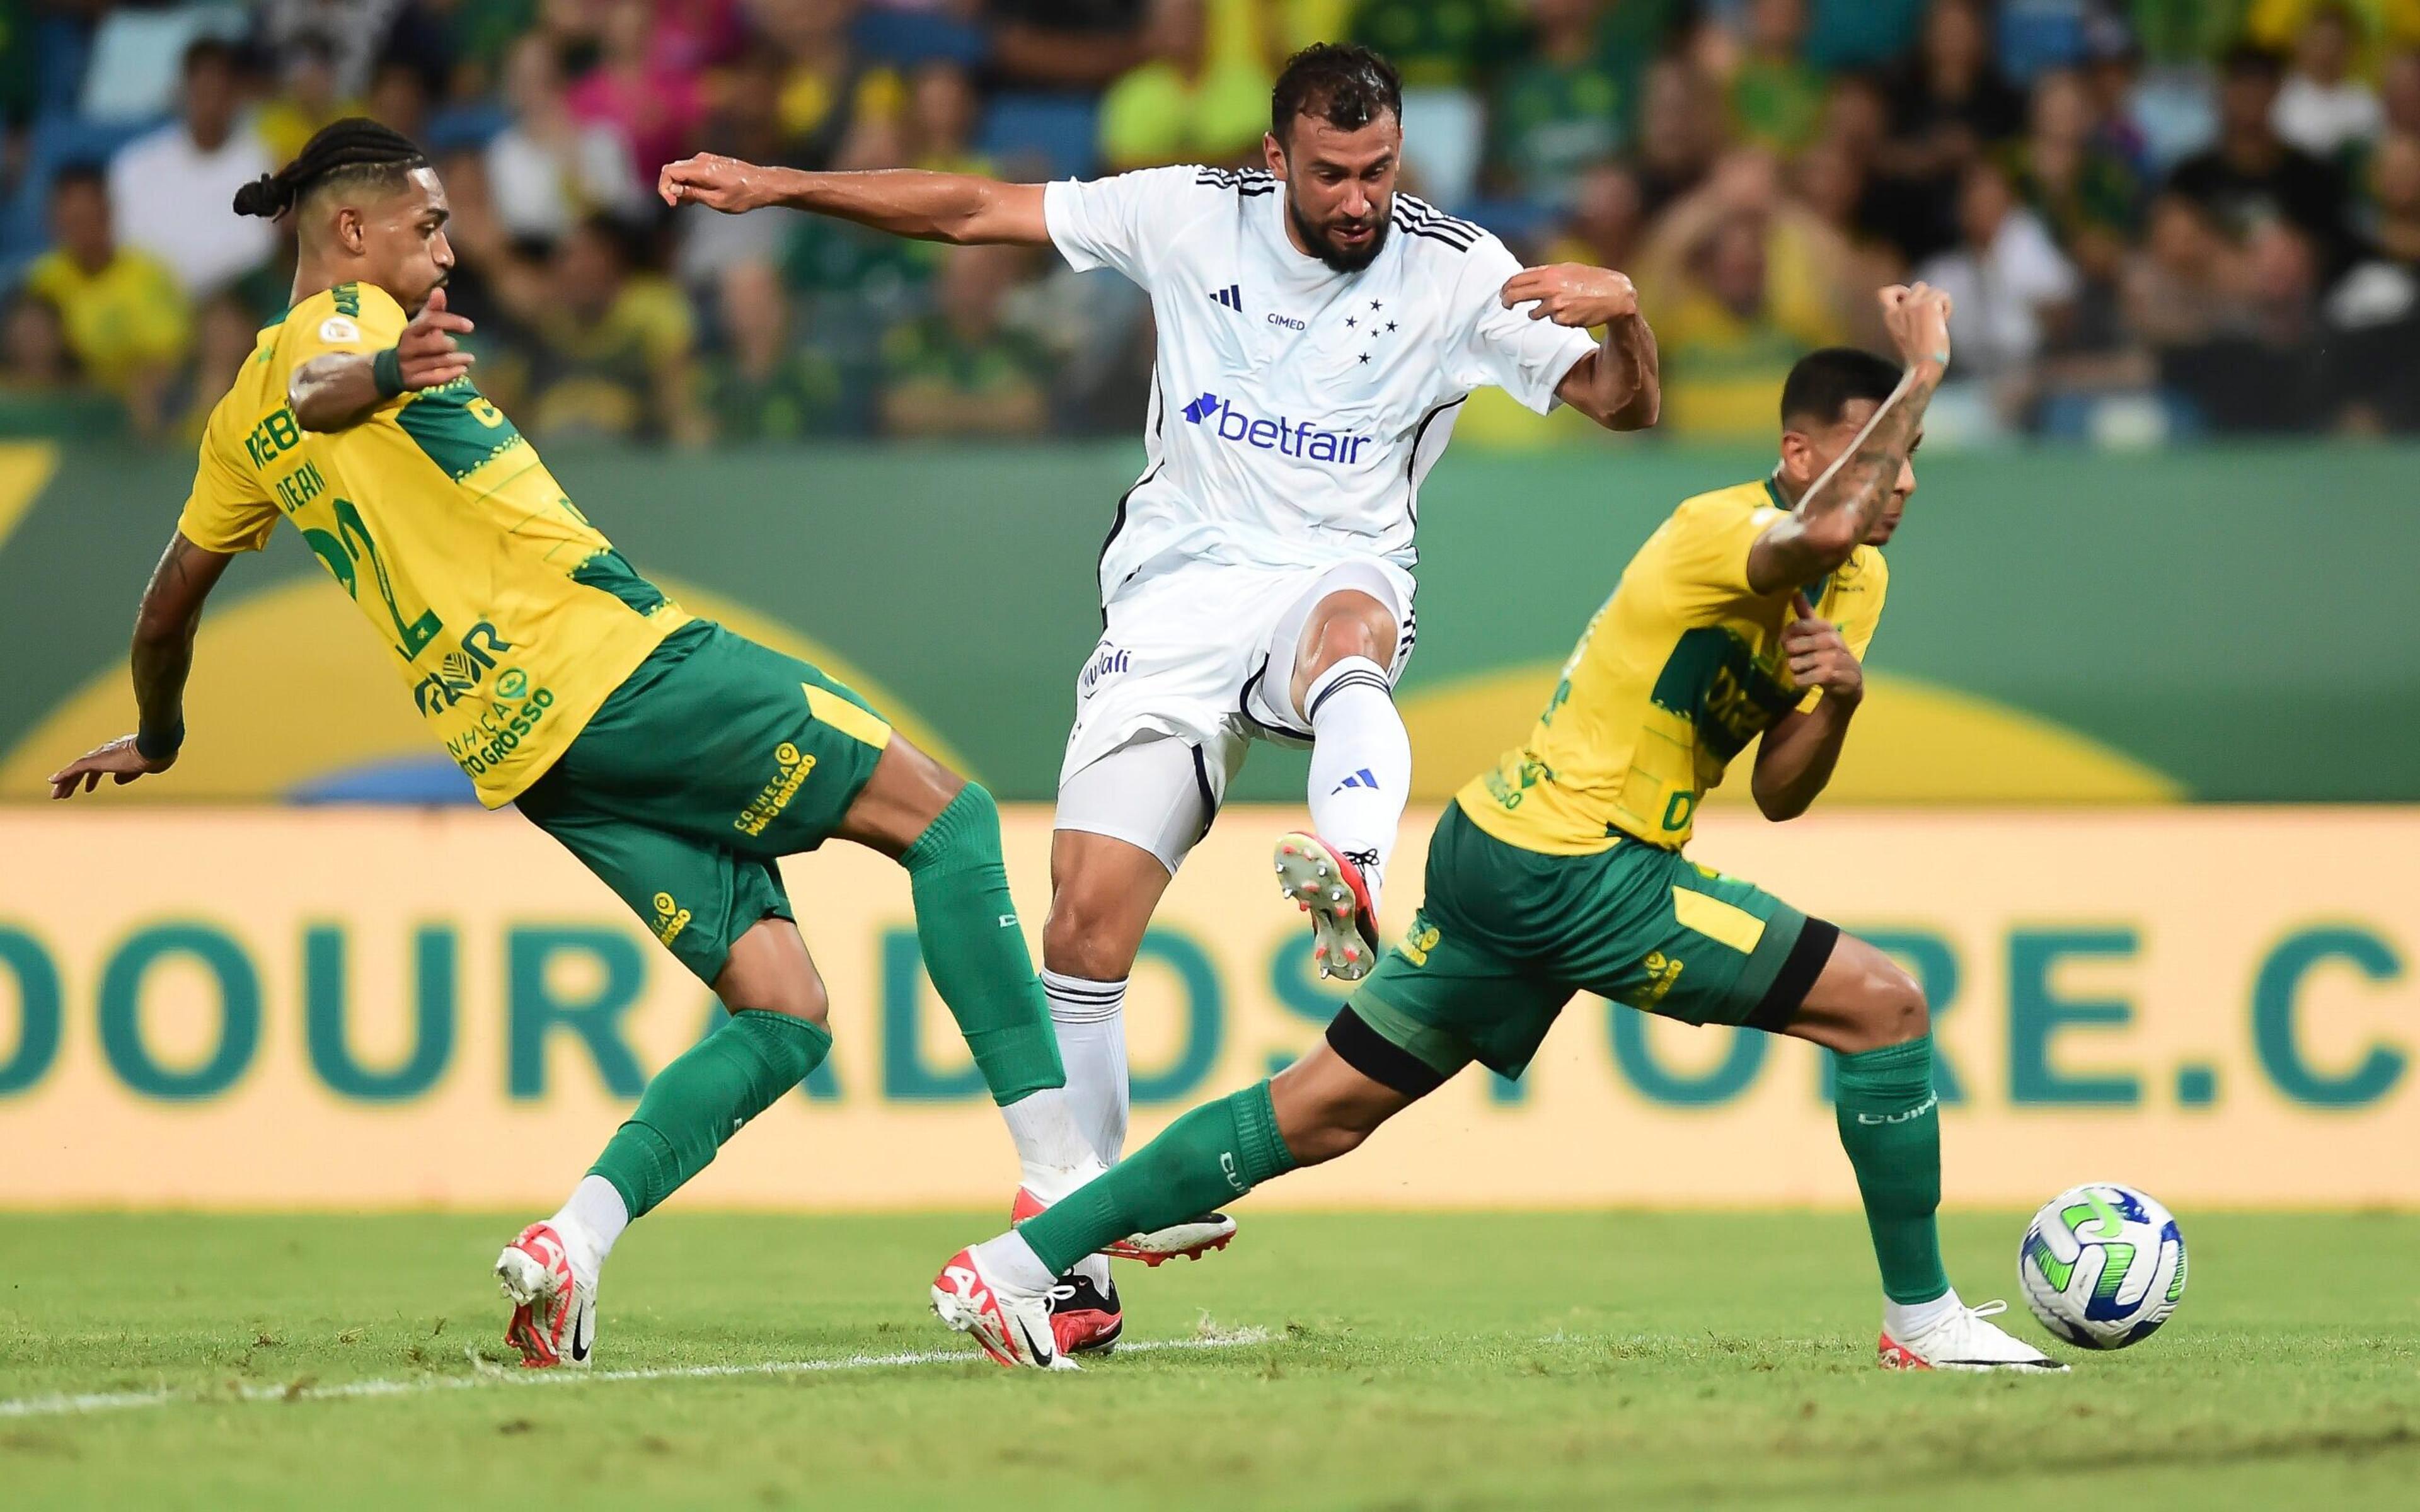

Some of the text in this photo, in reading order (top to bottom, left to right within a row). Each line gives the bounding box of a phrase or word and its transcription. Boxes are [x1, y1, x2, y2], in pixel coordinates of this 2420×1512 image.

[1267, 313, 1305, 331] CIMED
[1218, 399, 1372, 464] betfair
[480, 687, 555, 765] GROSSO
